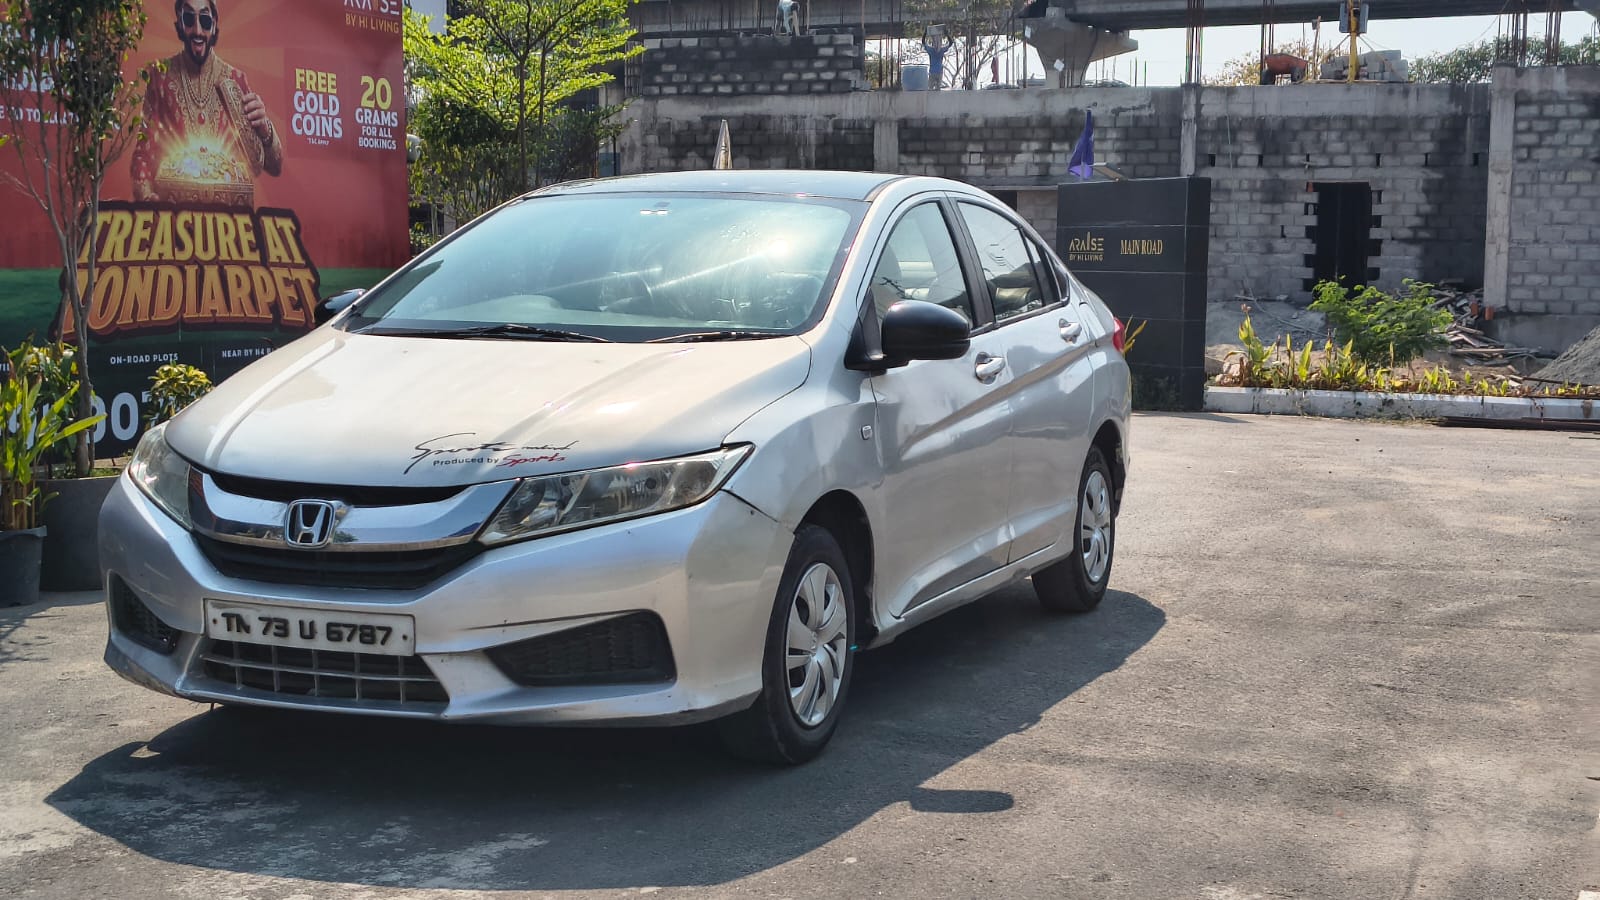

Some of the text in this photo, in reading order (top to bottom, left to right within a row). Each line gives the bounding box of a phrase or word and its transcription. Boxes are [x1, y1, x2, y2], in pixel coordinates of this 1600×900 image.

[370, 18, 399, 33] LIVING
[295, 68, 337, 94] FREE
[360, 75, 392, 110] 20
[293, 91, 340, 116] GOLD
[291, 113, 343, 139] COINS
[355, 107, 398, 127] GRAMS
[361, 126, 393, 138] FOR ALL
[358, 137, 397, 150] BOOKINGS
[77, 209, 306, 265] TREASURE AT
[1069, 231, 1163, 255] ARAISE MAIN ROAD
[1085, 254, 1103, 262] LIVING
[110, 353, 179, 365] ON-ROAD PLOTS
[222, 350, 242, 358] NEAR
[433, 452, 566, 468] Produced by Sports
[221, 612, 393, 646] TN 73 U 6787
